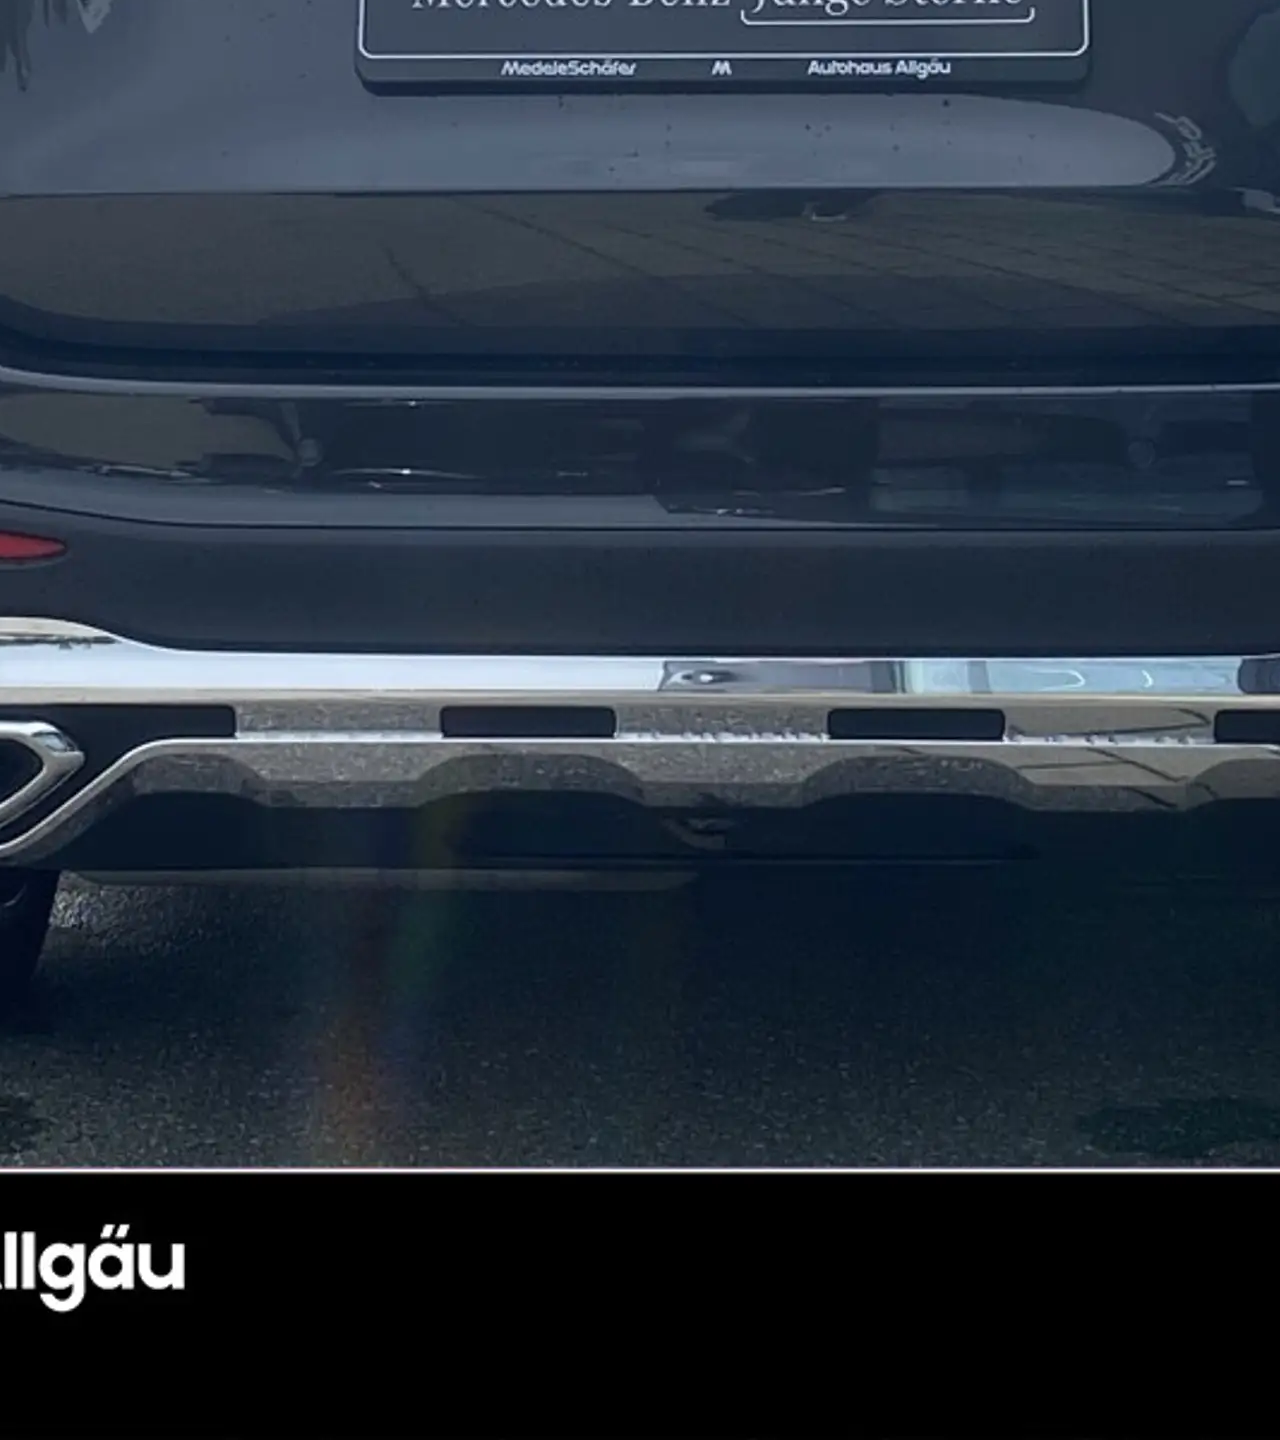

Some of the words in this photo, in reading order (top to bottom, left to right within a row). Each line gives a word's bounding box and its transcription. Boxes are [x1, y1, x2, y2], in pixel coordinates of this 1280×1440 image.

[500, 59, 637, 76] MedeleSchäfer
[807, 60, 893, 75] Autohaus
[895, 59, 951, 79] Allgäu
